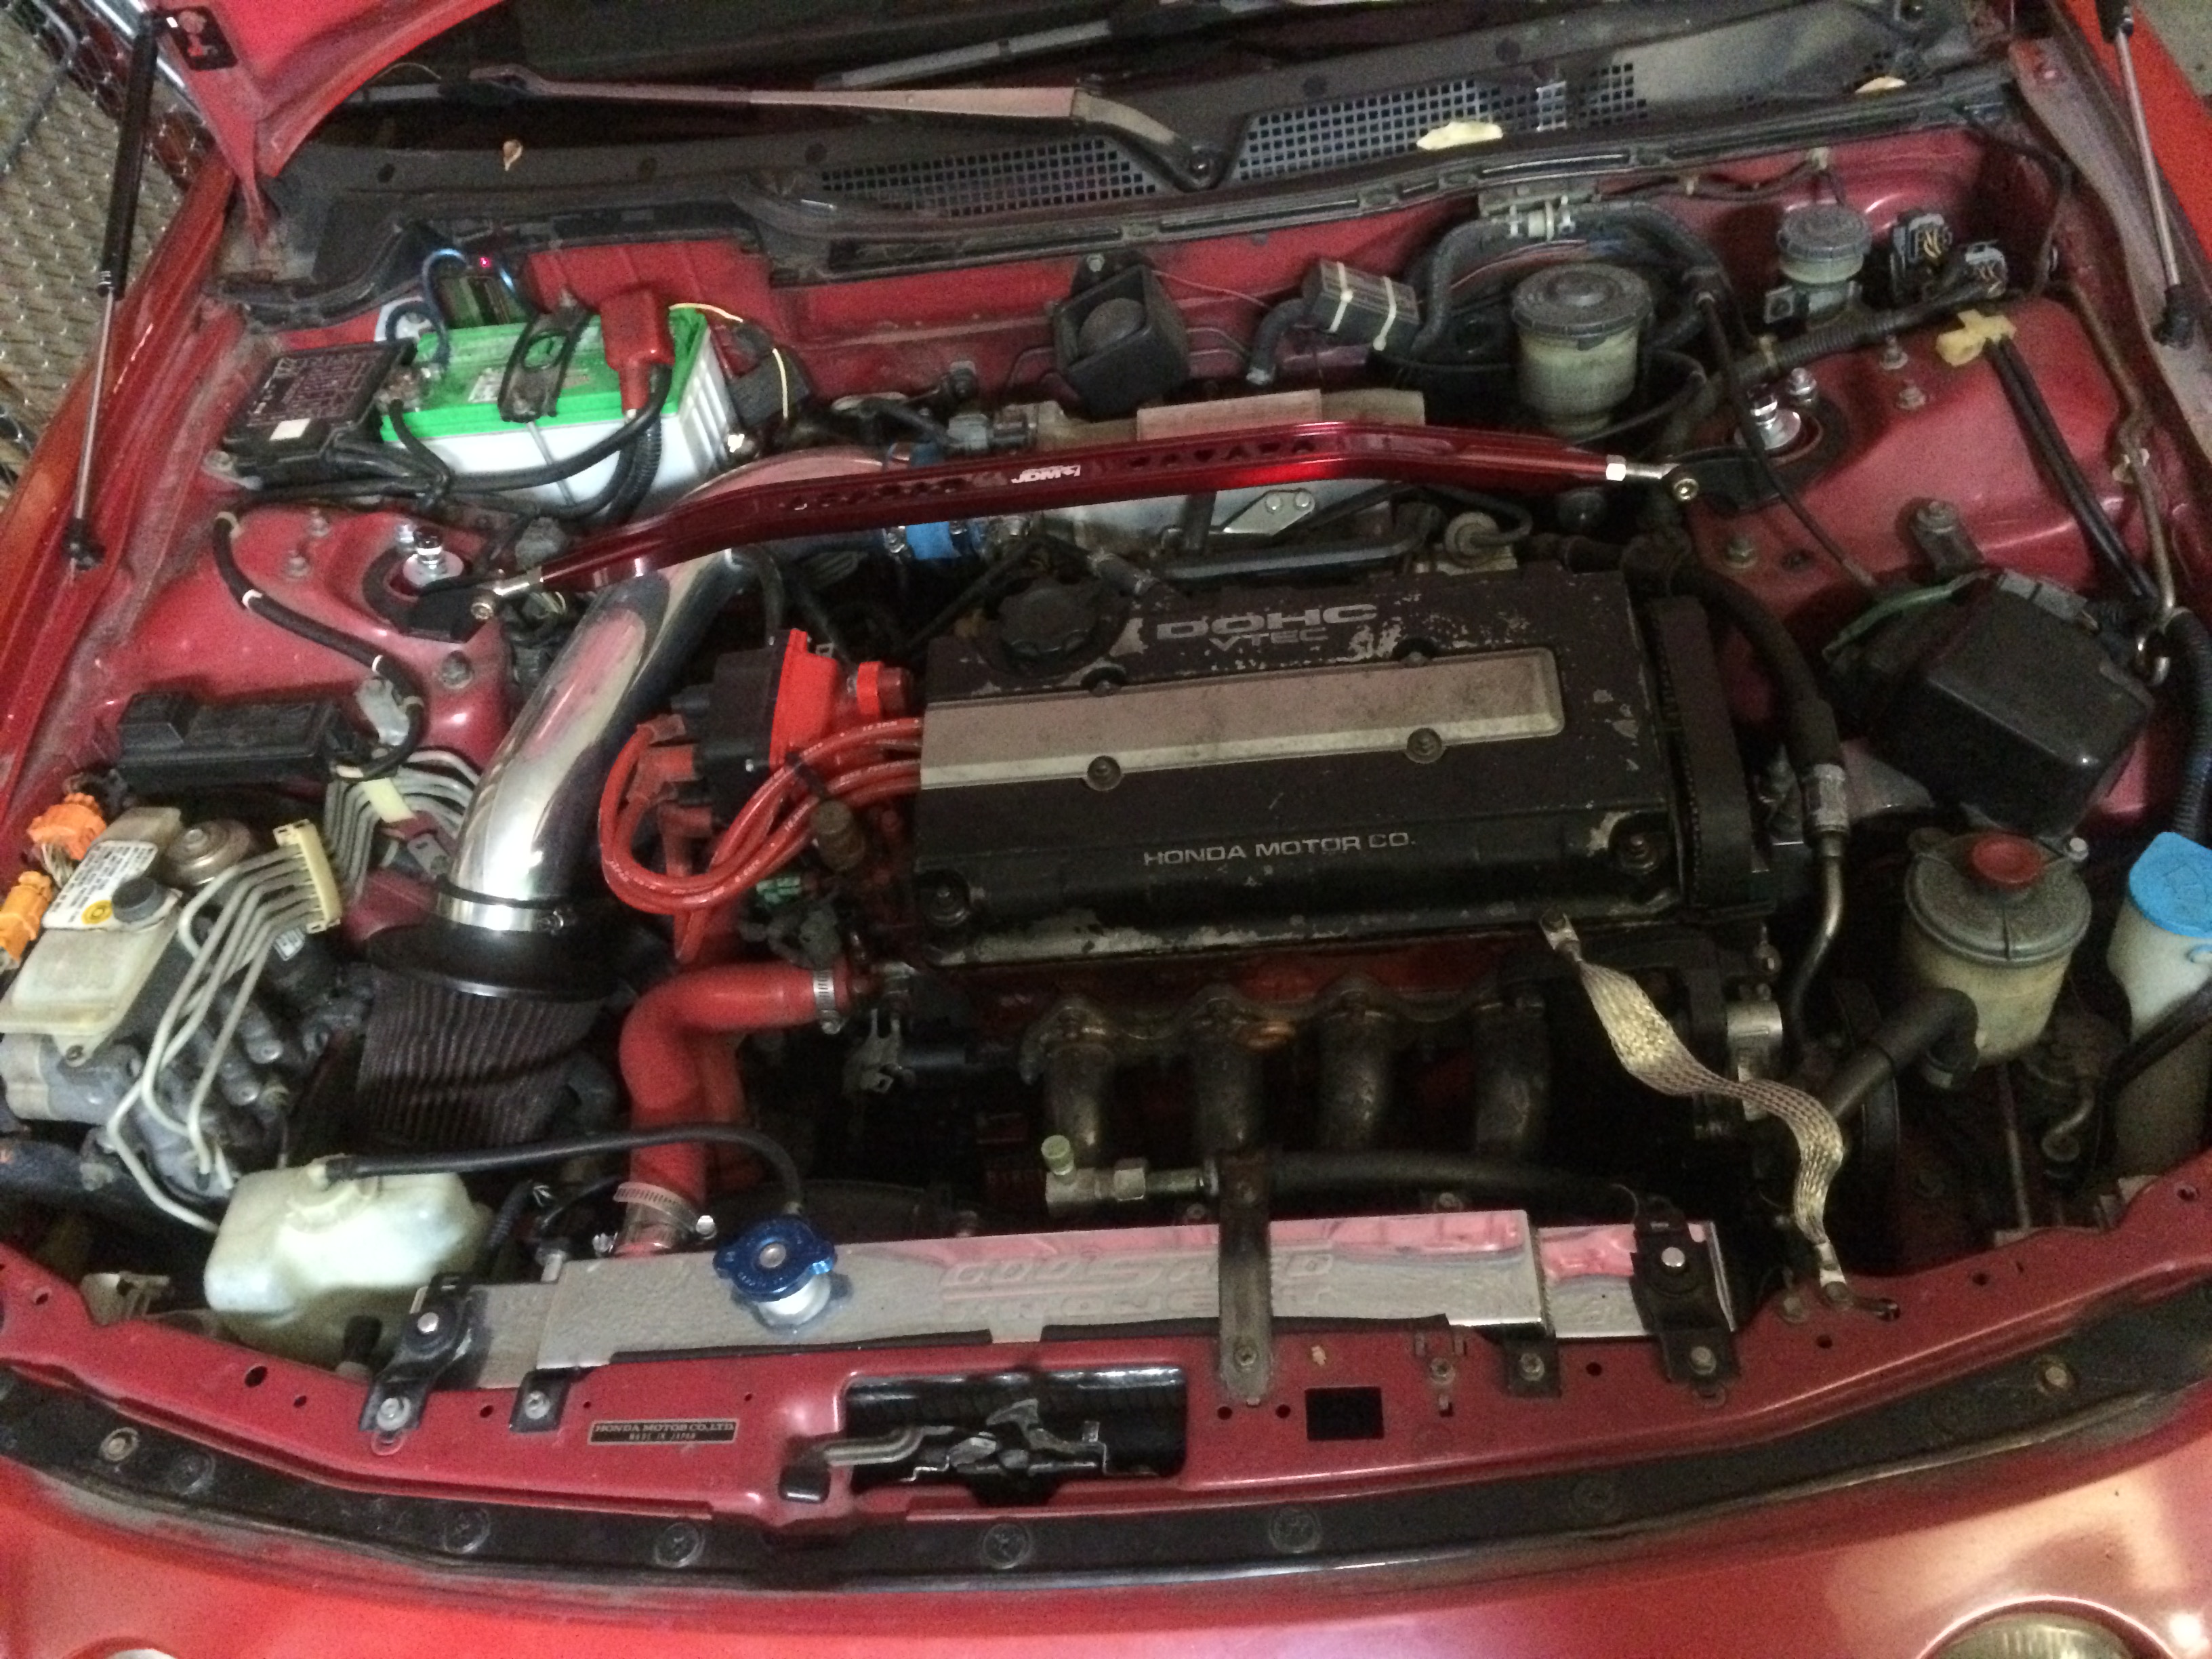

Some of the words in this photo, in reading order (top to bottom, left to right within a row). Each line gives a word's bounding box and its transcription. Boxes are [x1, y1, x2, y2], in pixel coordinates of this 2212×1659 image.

[1157, 604, 1377, 640] DOHC
[1209, 626, 1329, 651] VTEC
[1144, 844, 1246, 866] HONDA
[1255, 836, 1361, 857] MOTOR
[1368, 832, 1416, 848] CO.
[595, 1423, 640, 1432] HONDA
[642, 1423, 687, 1431] MOTOR
